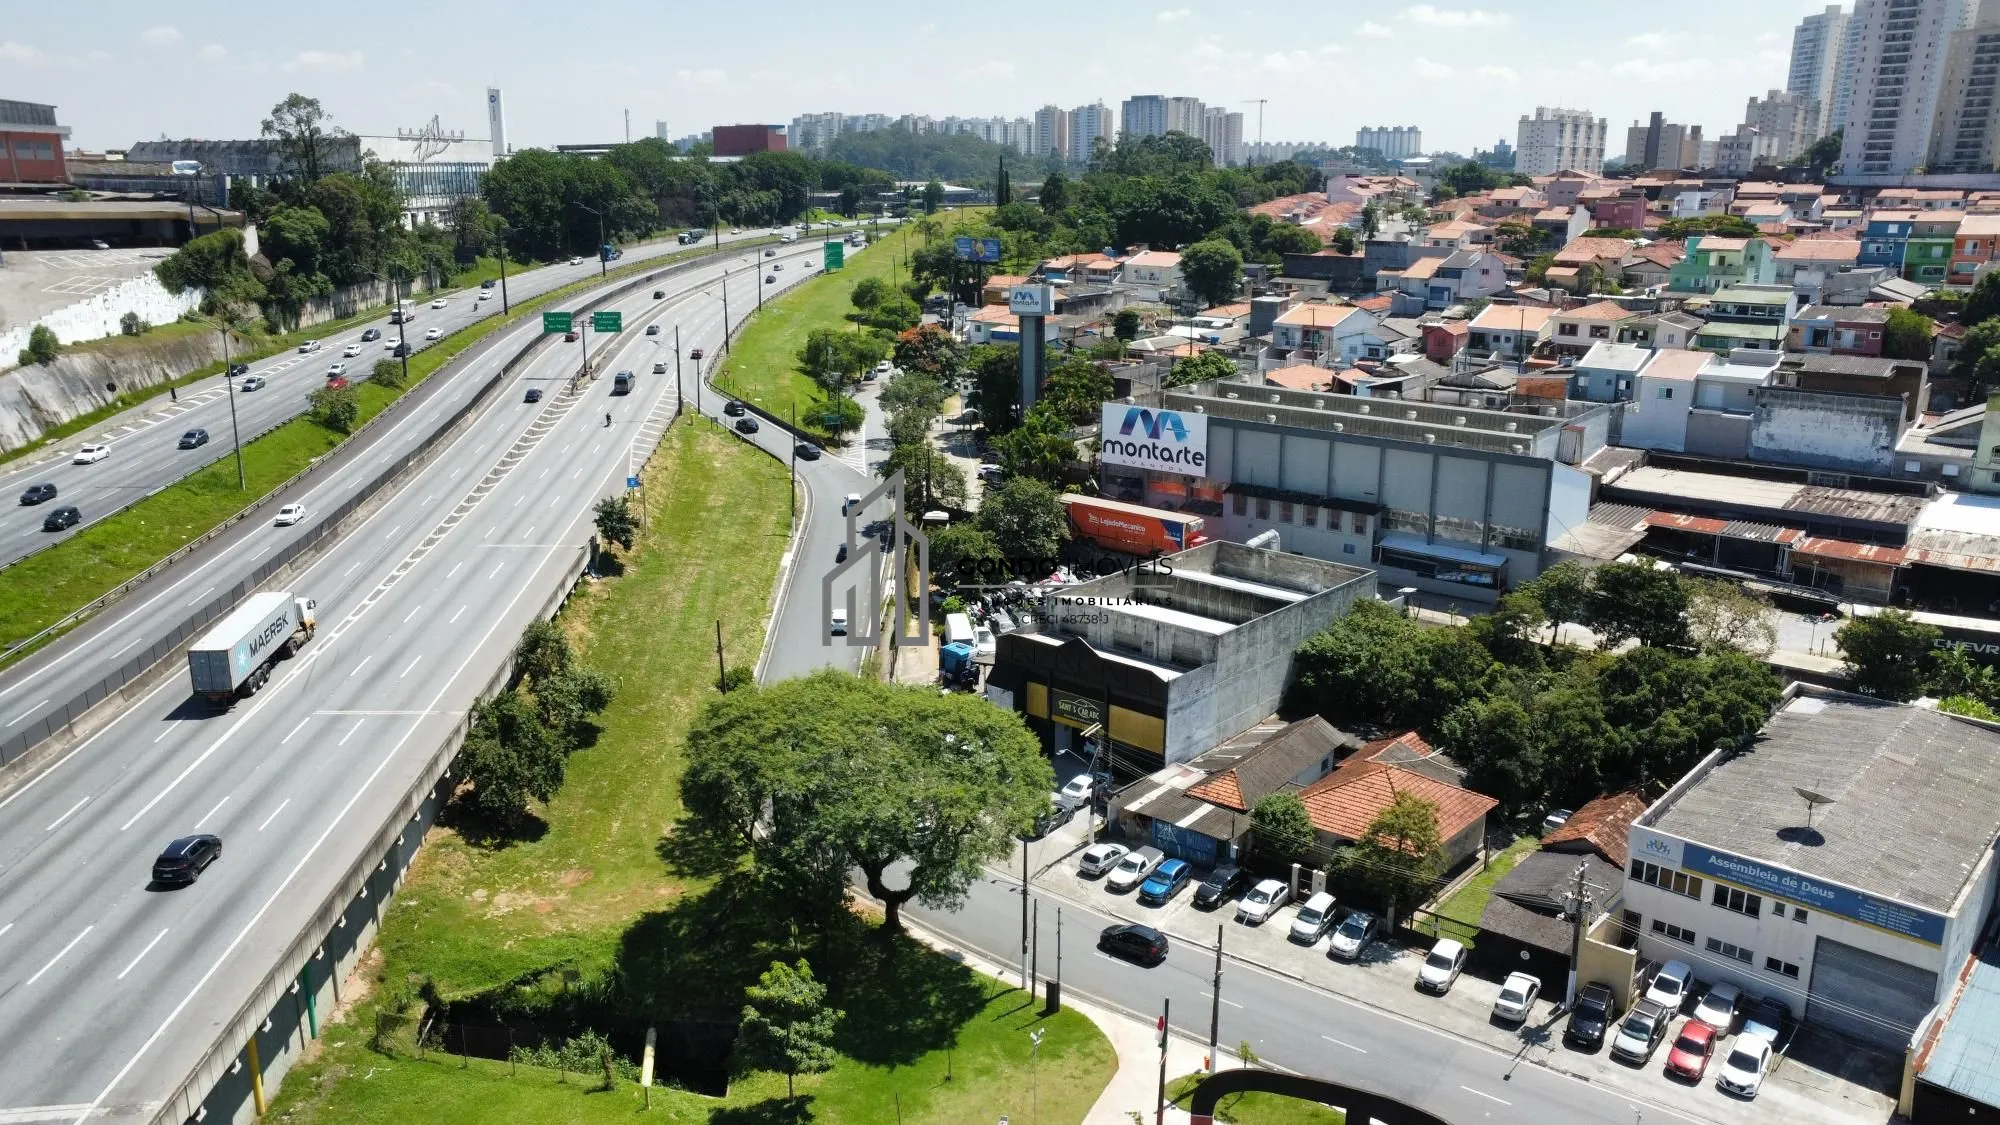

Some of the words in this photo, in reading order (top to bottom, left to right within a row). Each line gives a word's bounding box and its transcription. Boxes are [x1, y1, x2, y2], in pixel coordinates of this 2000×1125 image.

[1103, 439, 1205, 467] montarte
[249, 611, 289, 658] MAERSK
[1077, 707, 1091, 719] CAR
[1089, 710, 1100, 720] ABC
[1708, 855, 1778, 882] Assembleia
[1782, 876, 1798, 889] de
[1801, 881, 1836, 899] Deus
